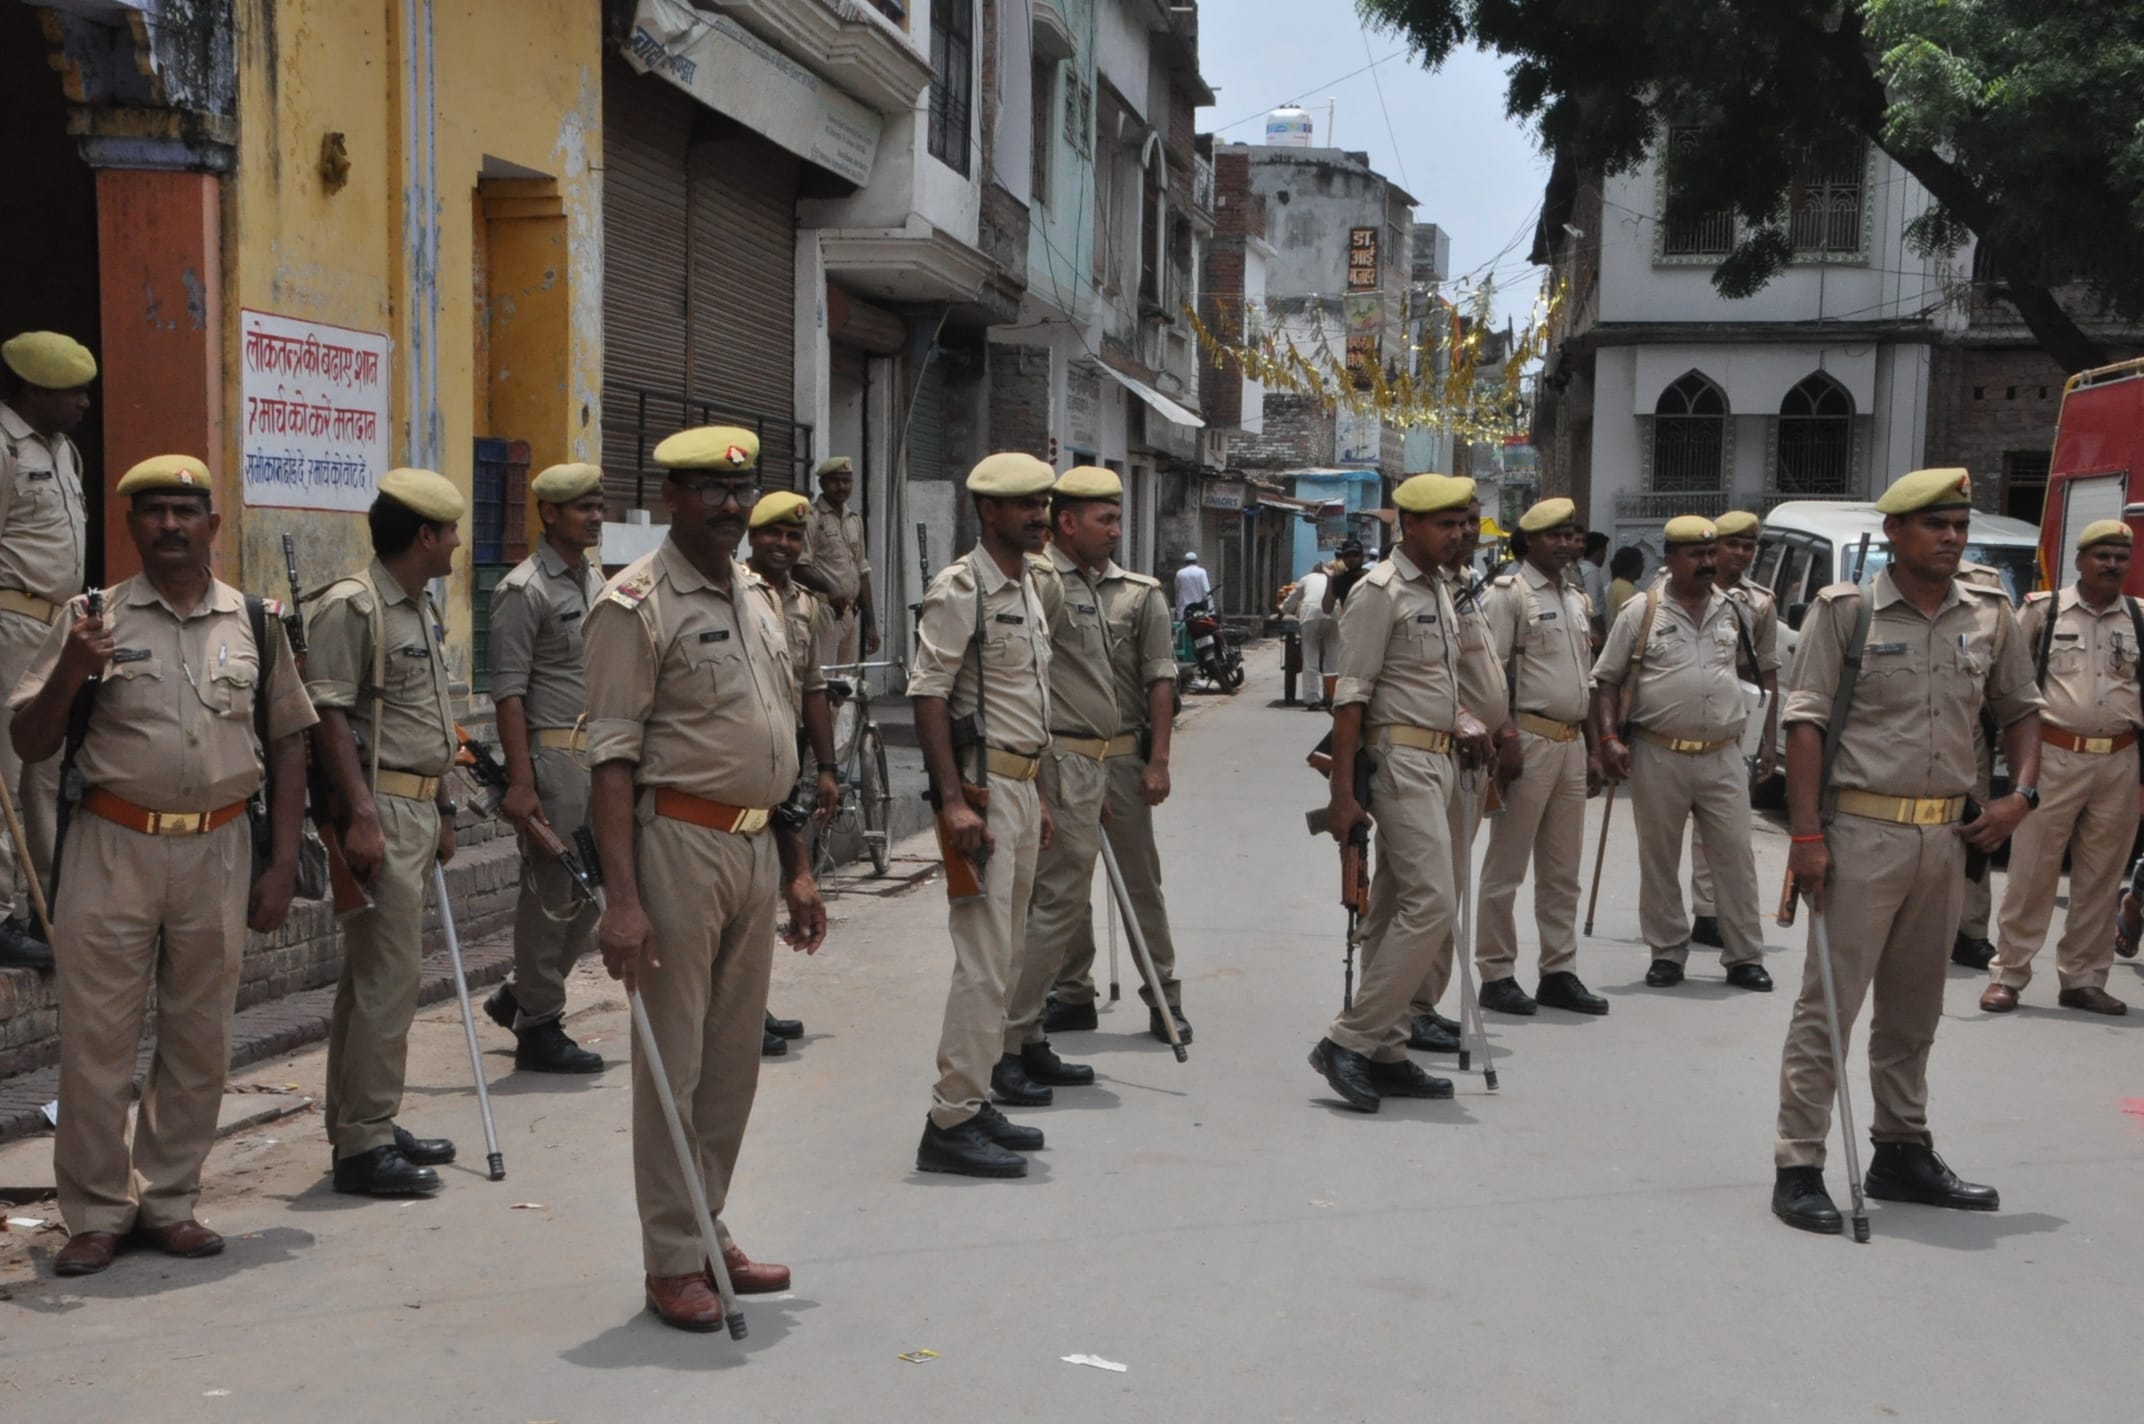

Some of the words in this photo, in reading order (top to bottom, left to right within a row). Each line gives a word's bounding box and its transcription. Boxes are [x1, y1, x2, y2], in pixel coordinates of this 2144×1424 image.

[305, 332, 320, 377] की
[354, 350, 379, 393] शान
[248, 396, 257, 436] 7
[259, 383, 288, 438] मार्च
[289, 389, 309, 437] को
[333, 407, 377, 448] मतदान
[245, 446, 264, 488] सभी
[264, 456, 283, 486] काम
[313, 450, 330, 487] मार्च
[330, 452, 343, 489] को
[343, 453, 358, 489] वोट
